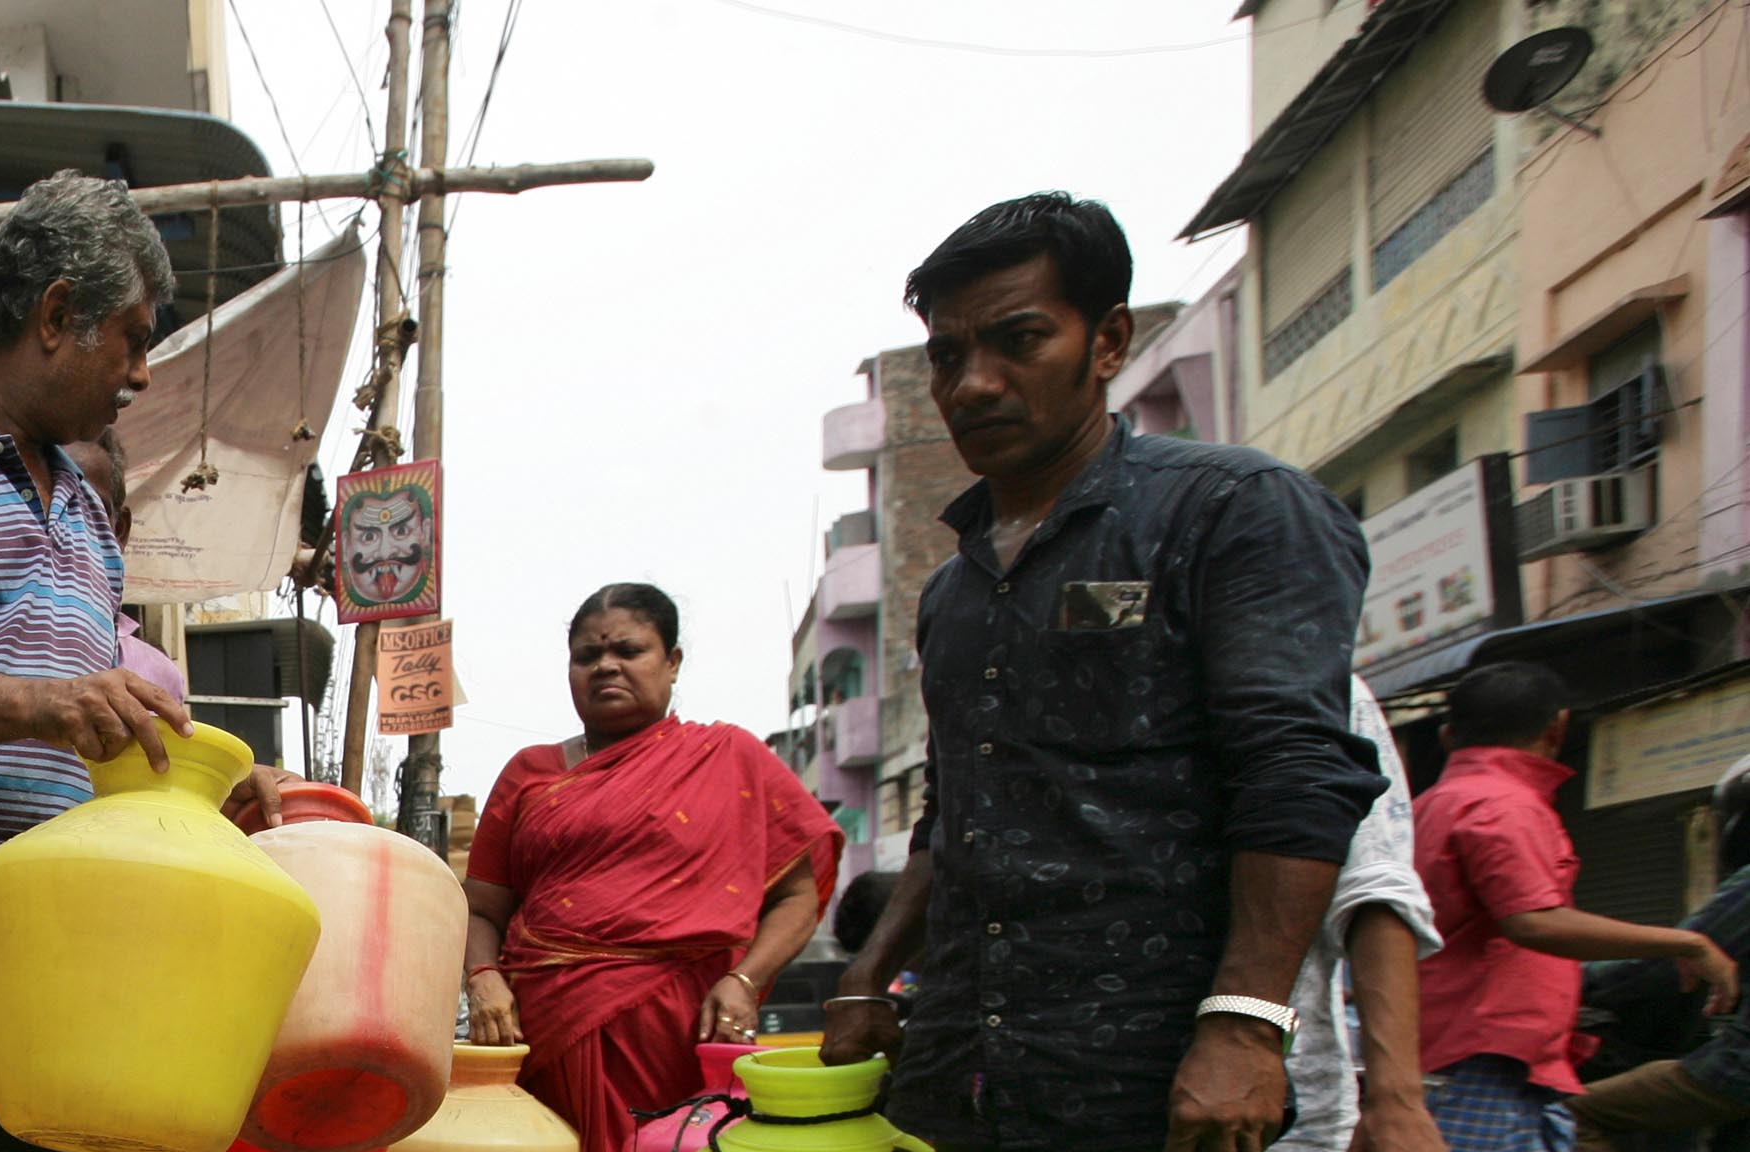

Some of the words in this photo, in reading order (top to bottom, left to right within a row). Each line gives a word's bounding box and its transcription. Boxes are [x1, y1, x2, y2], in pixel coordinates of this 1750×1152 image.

[382, 623, 451, 650] MS-OFFICE
[391, 651, 443, 677] Tally
[391, 681, 443, 703] CSC
